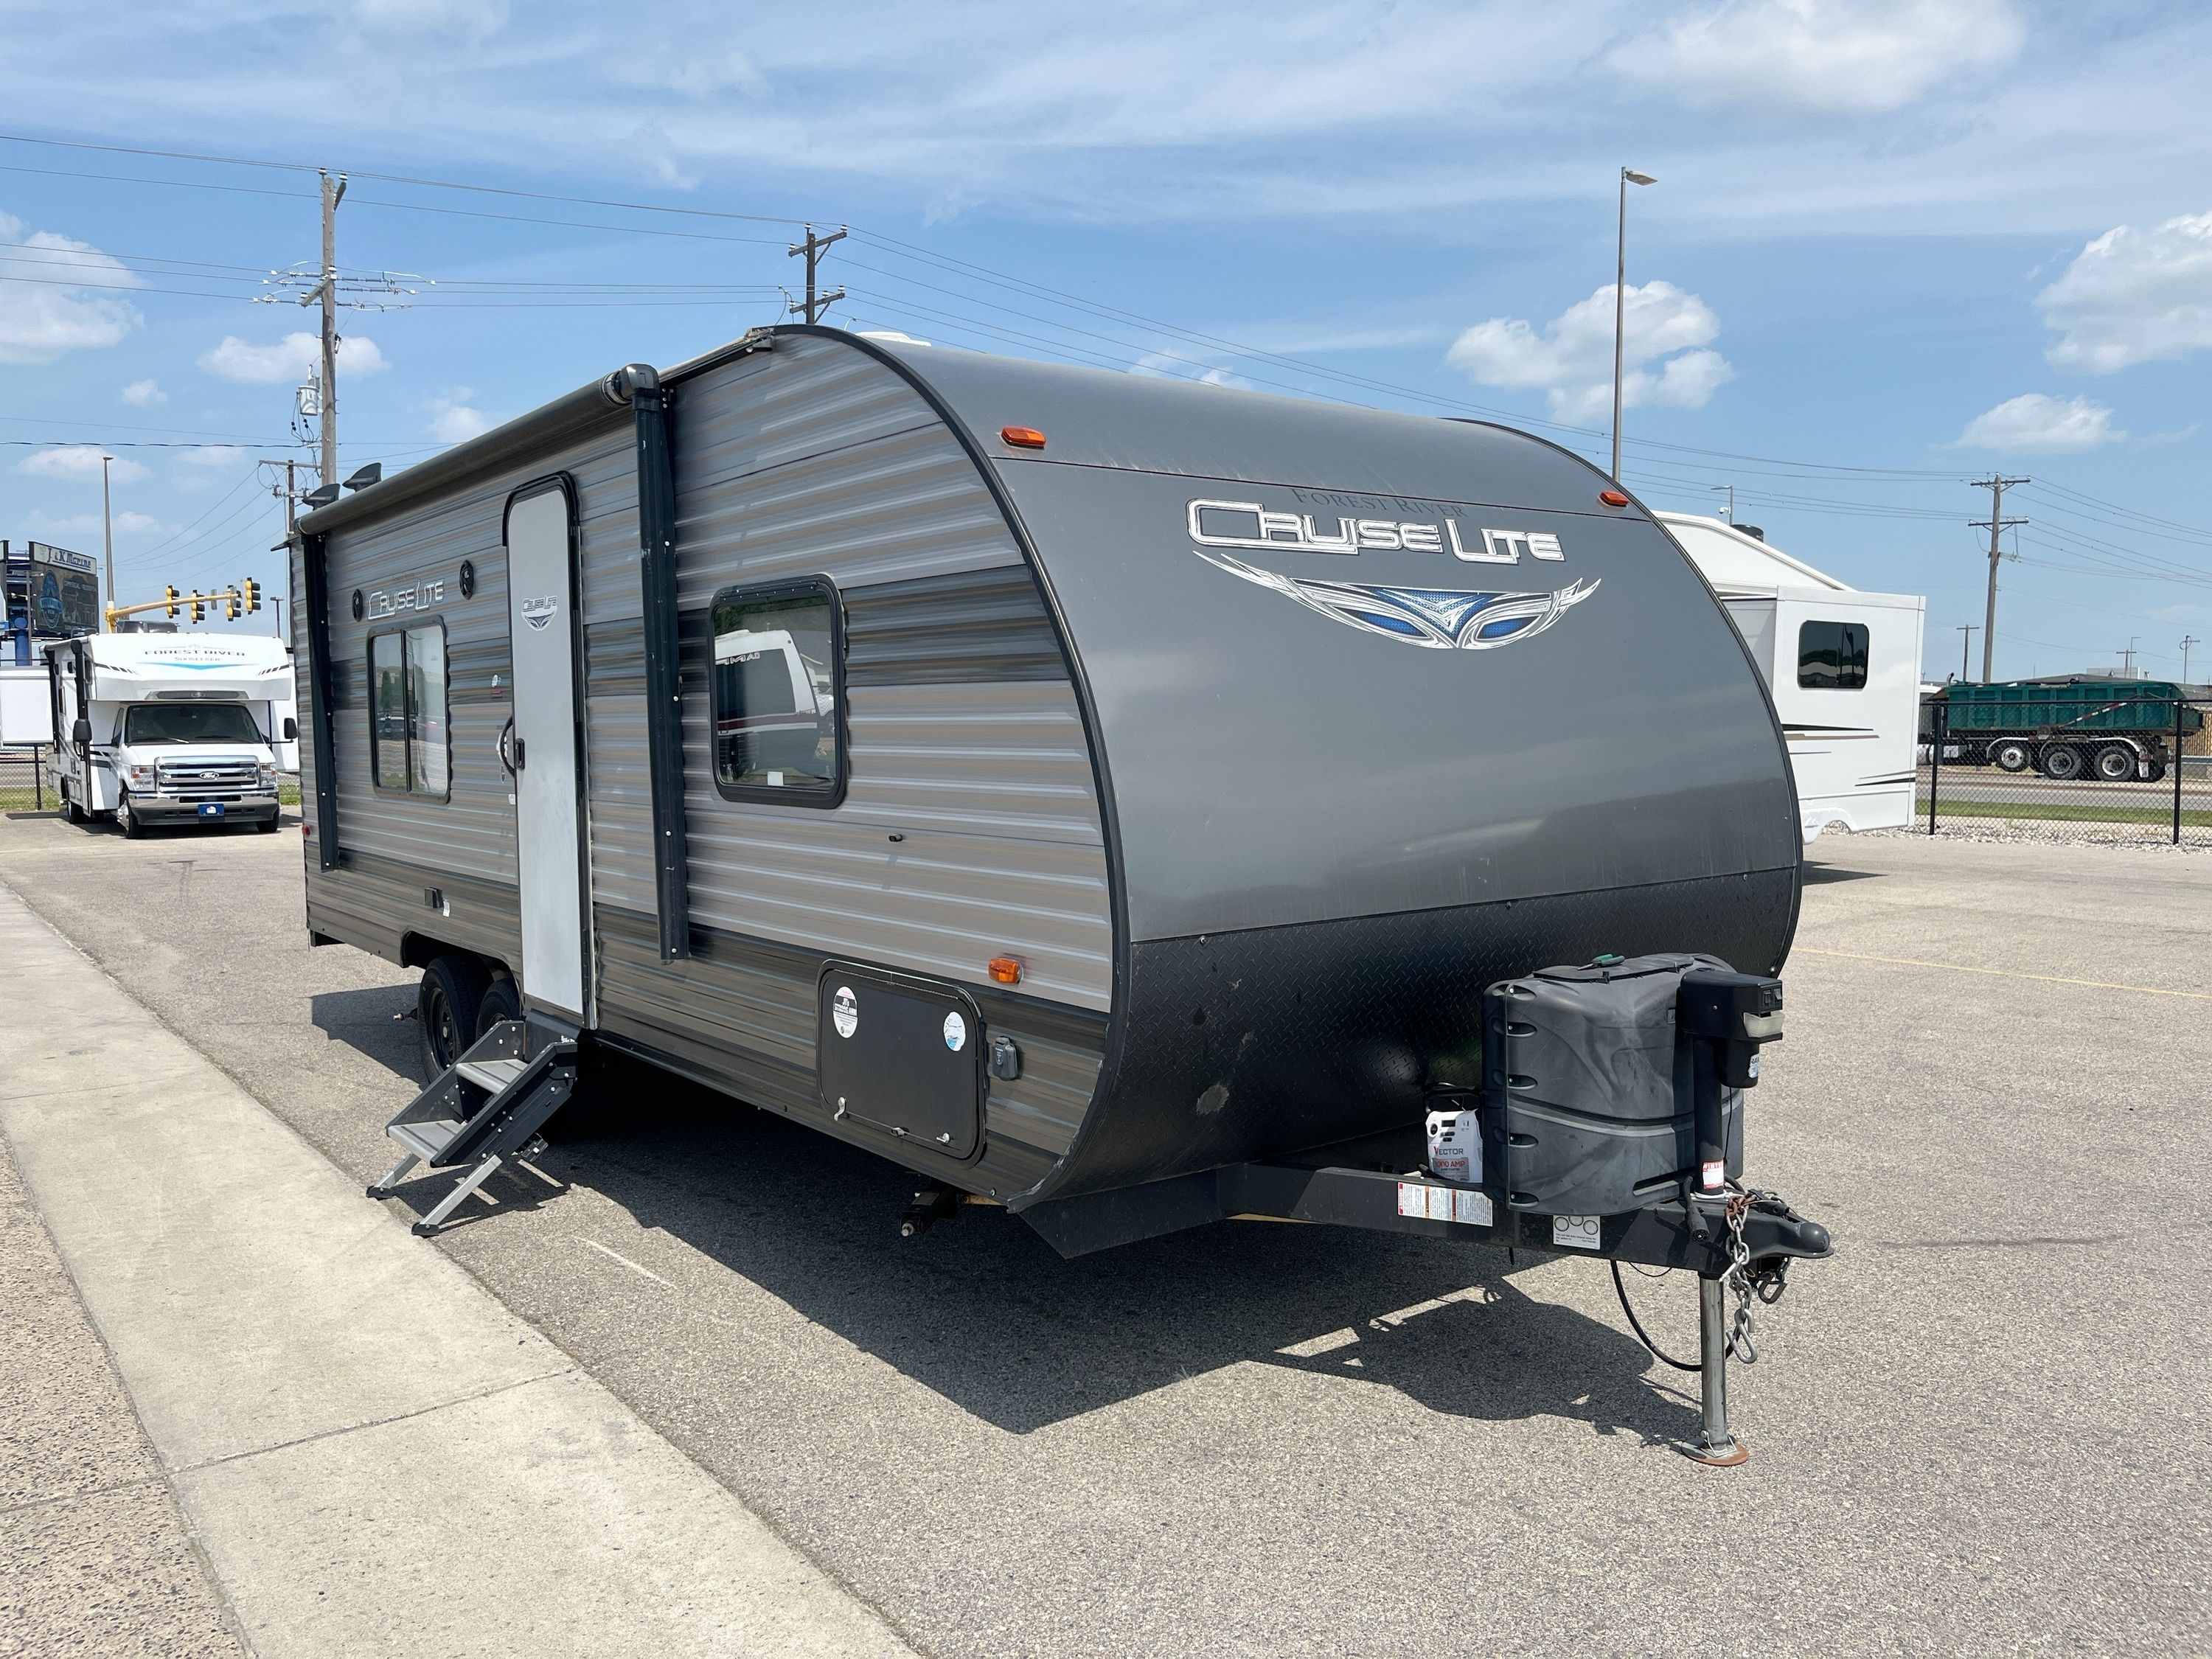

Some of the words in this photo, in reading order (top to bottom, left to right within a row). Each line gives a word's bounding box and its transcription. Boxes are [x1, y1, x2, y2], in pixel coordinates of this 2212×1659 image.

[1291, 489, 1389, 512] FOREST
[1396, 497, 1469, 518] RIVER
[1433, 1146, 1464, 1155] VECTOR
